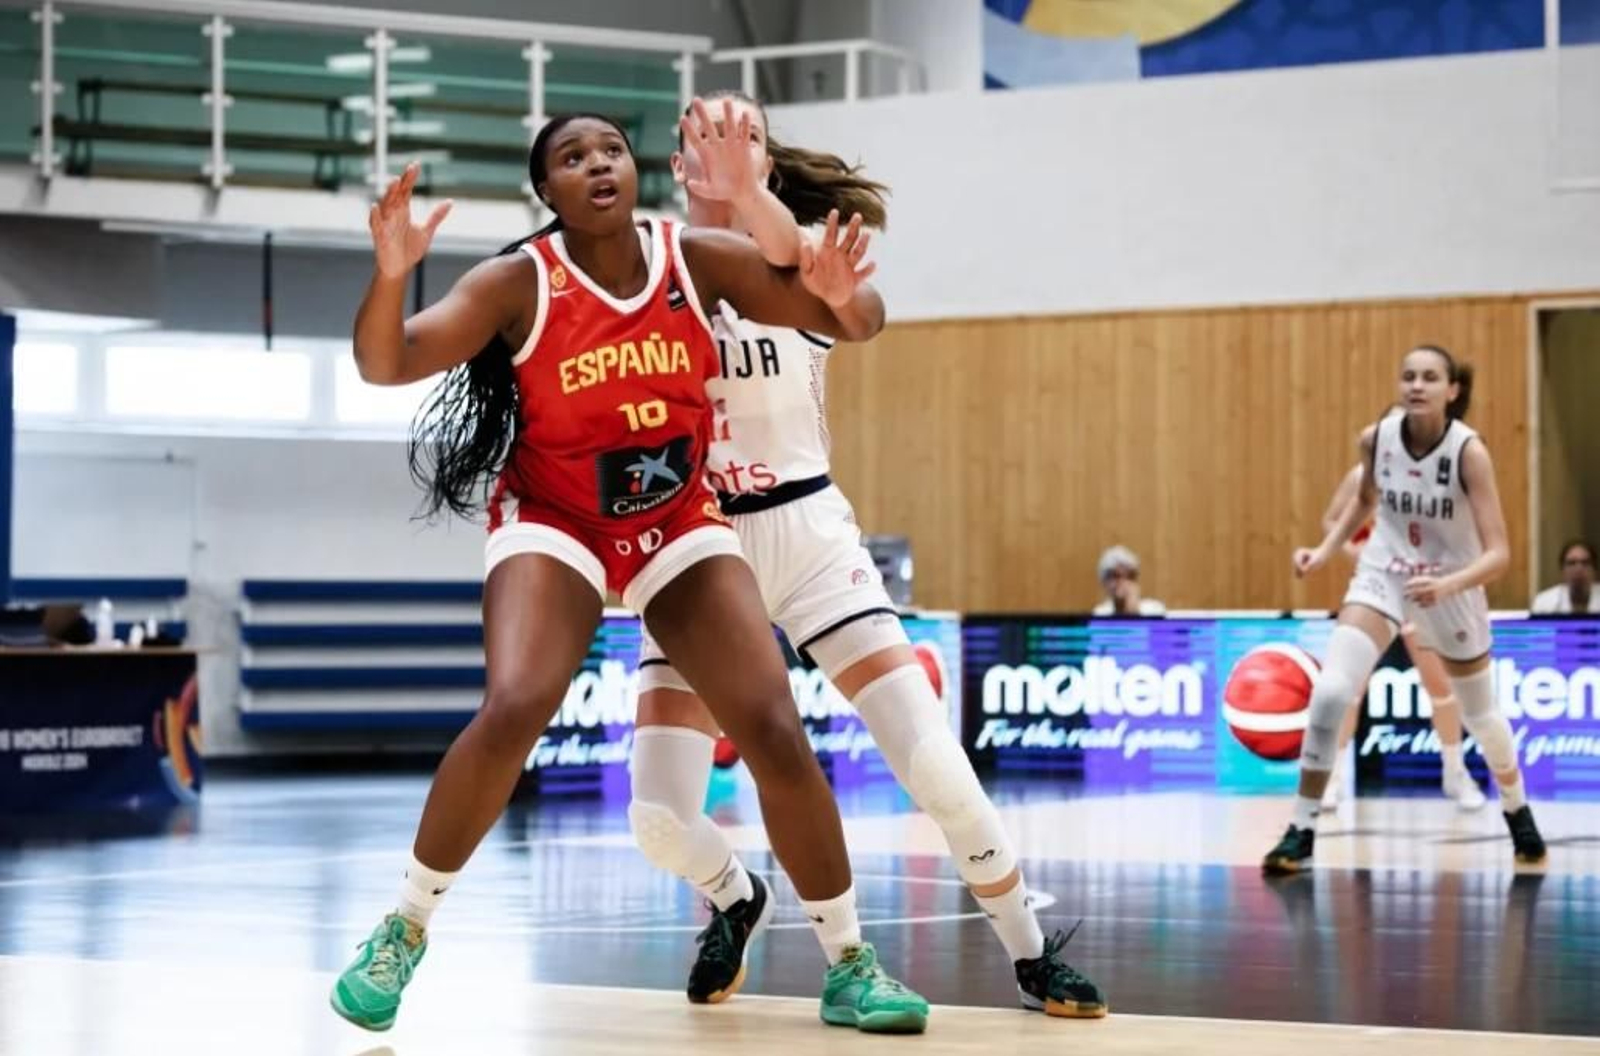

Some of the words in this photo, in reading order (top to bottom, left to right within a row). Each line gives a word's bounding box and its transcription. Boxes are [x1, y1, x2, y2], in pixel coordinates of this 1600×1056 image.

[558, 332, 691, 396] ESPAÑA
[718, 337, 780, 379] IJA
[617, 399, 669, 432] 10
[1378, 489, 1455, 521] RBIJA
[1408, 521, 1422, 547] 6
[982, 655, 1203, 717] molten
[1368, 657, 1600, 720] mten
[974, 718, 1022, 750] For
[1360, 724, 1412, 756] For
